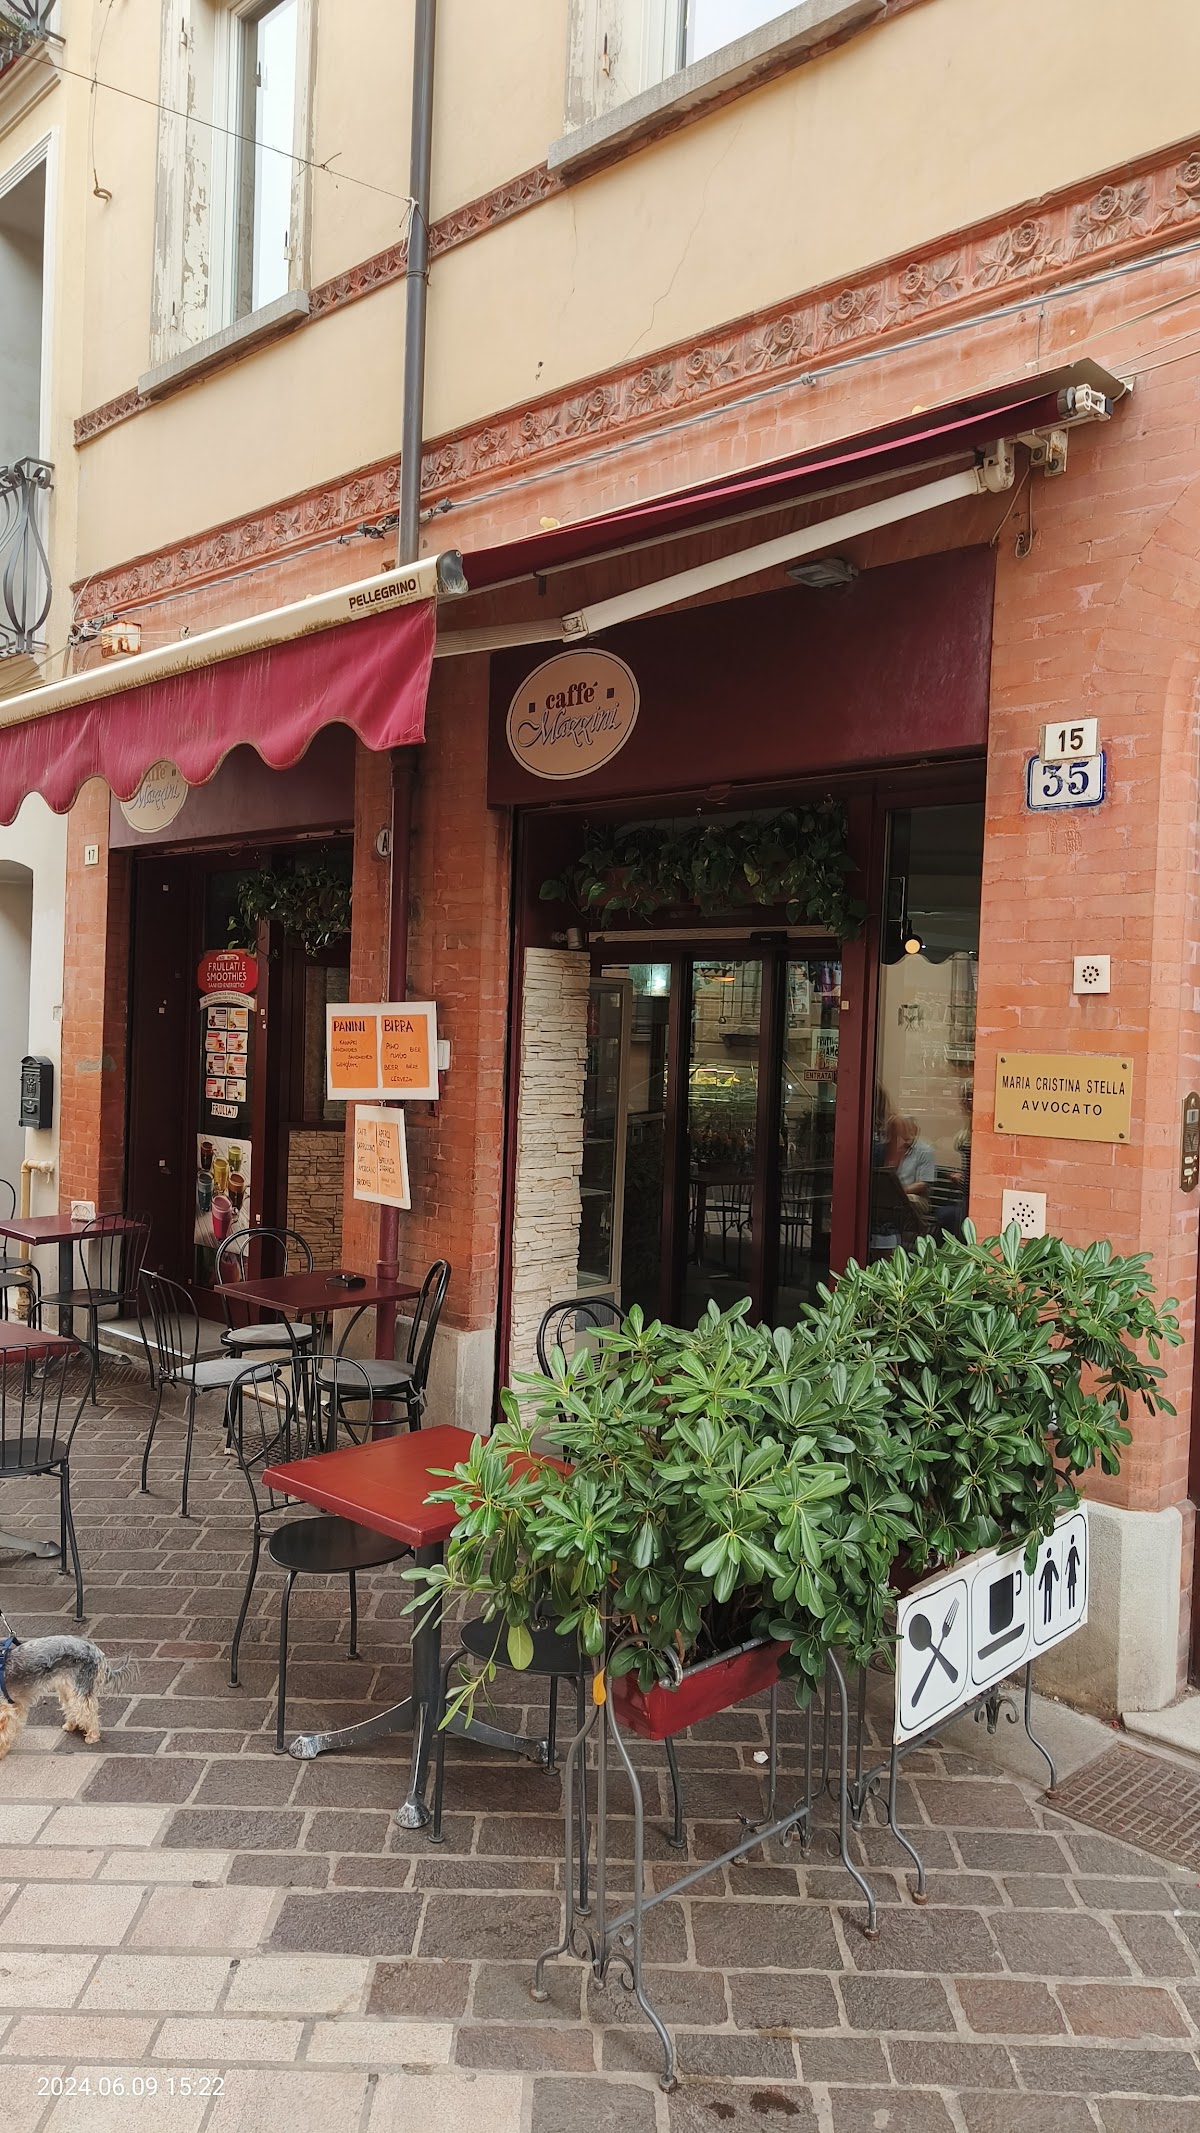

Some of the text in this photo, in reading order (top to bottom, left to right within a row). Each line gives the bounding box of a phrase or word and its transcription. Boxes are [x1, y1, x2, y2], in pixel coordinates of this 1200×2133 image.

[348, 578, 417, 609] PELLEGRINO
[517, 701, 622, 748] Mazzini
[1058, 727, 1084, 752] 15
[1042, 761, 1090, 797] 35
[88, 849, 95, 861] 17
[208, 962, 240, 972] FRULLATI
[206, 971, 247, 981] SMOOTHIES
[333, 1020, 366, 1032] PANINI
[384, 1019, 414, 1033] BIRRA
[805, 1072, 832, 1080] ENTRATA
[1002, 1075, 1125, 1096] MARIA CRISTINA STELLA
[212, 1104, 237, 1117] FRULLATI
[1021, 1100, 1102, 1116] AVVOCATO
